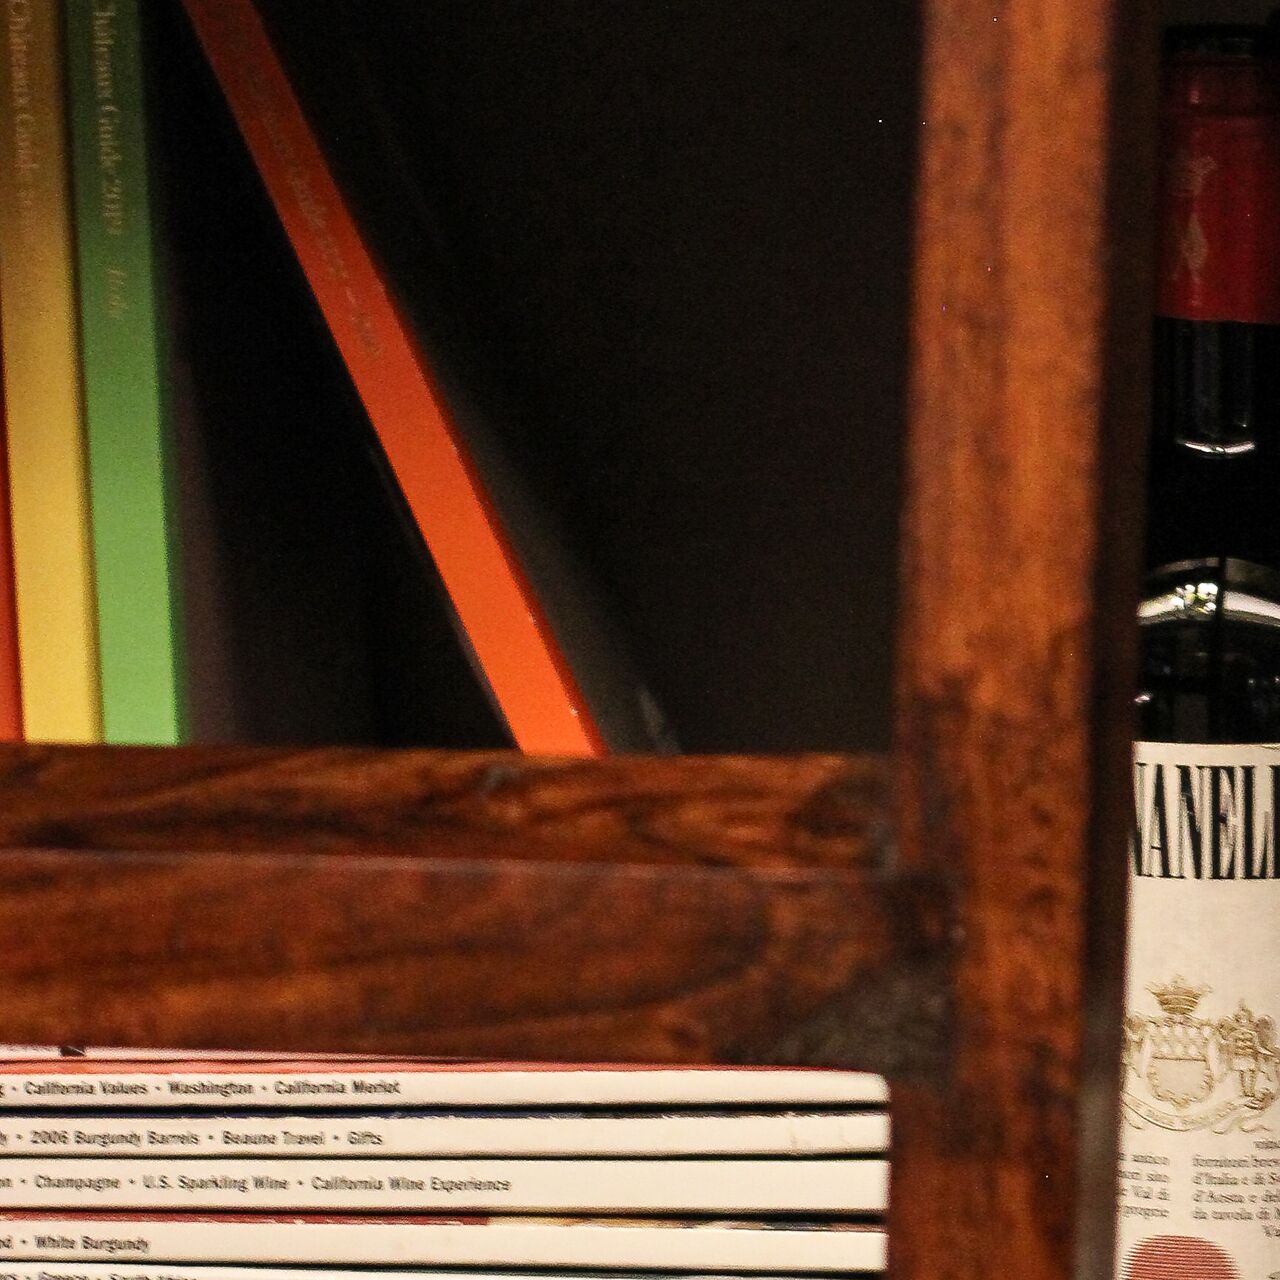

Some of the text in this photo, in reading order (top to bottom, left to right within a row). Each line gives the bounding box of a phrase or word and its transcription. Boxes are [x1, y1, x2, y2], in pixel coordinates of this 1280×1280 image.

[24, 1081, 96, 1097] California
[100, 1081, 148, 1096] Values
[167, 1081, 254, 1098] Washington
[273, 1080, 346, 1096] California
[352, 1080, 401, 1096] Merlot
[74, 1130, 142, 1147] Burgundy
[147, 1130, 201, 1145] Barrels
[222, 1130, 277, 1145] Beaune
[281, 1130, 325, 1145] Travel
[346, 1130, 384, 1146] Gifts
[34, 1174, 512, 1194] Champagne U.S. Sparkling Wine California Wine Experience
[34, 1234, 150, 1254] White Burgundy
